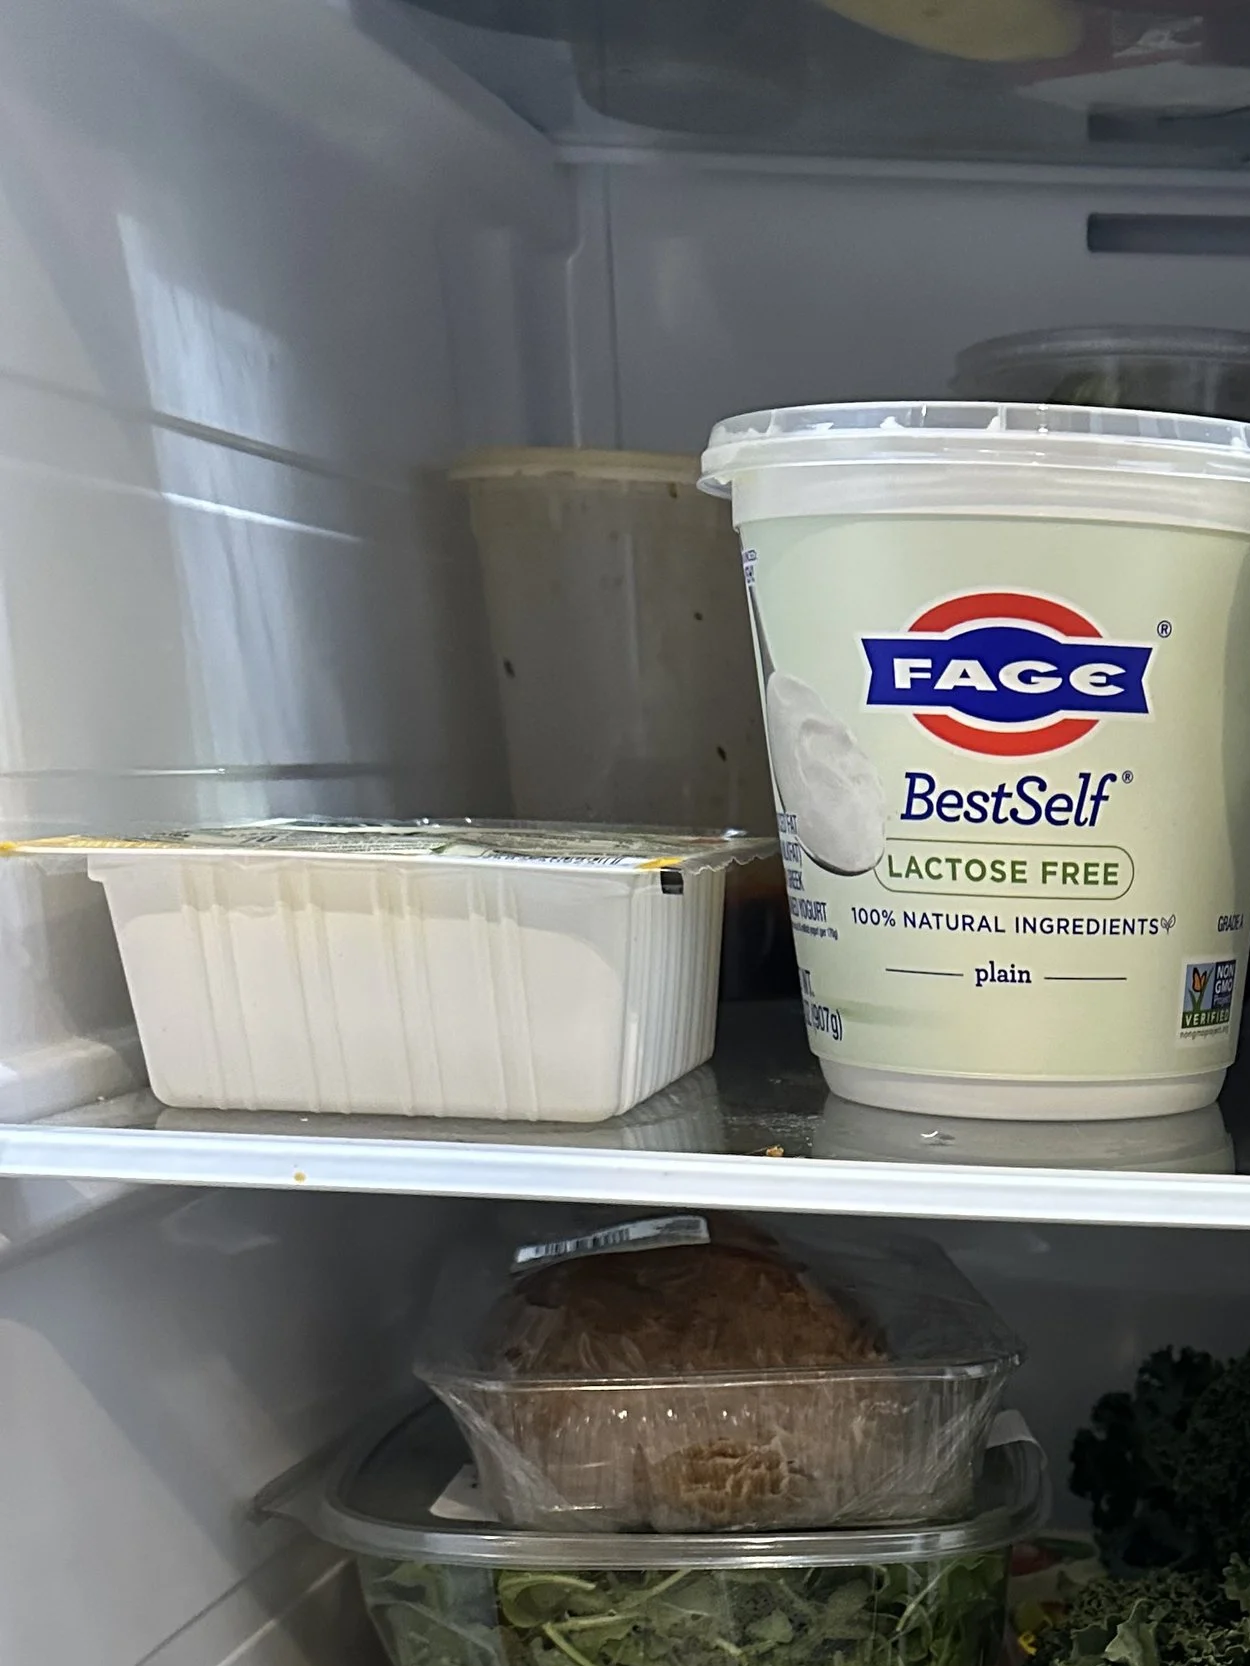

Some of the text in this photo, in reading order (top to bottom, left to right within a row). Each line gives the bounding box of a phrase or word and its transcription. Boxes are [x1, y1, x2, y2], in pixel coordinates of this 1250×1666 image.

[893, 658, 1126, 696] FAGE
[900, 771, 1118, 827] BestSelf
[887, 855, 1119, 886] LACTOSE FREE
[851, 906, 1159, 936] 100% NATURAL INGREDIENTS
[1217, 914, 1239, 932] GRADE
[974, 961, 1032, 987] plain
[1216, 964, 1235, 979] NON
[1214, 979, 1233, 994] GMO
[1184, 1009, 1230, 1026] VERIFIED
